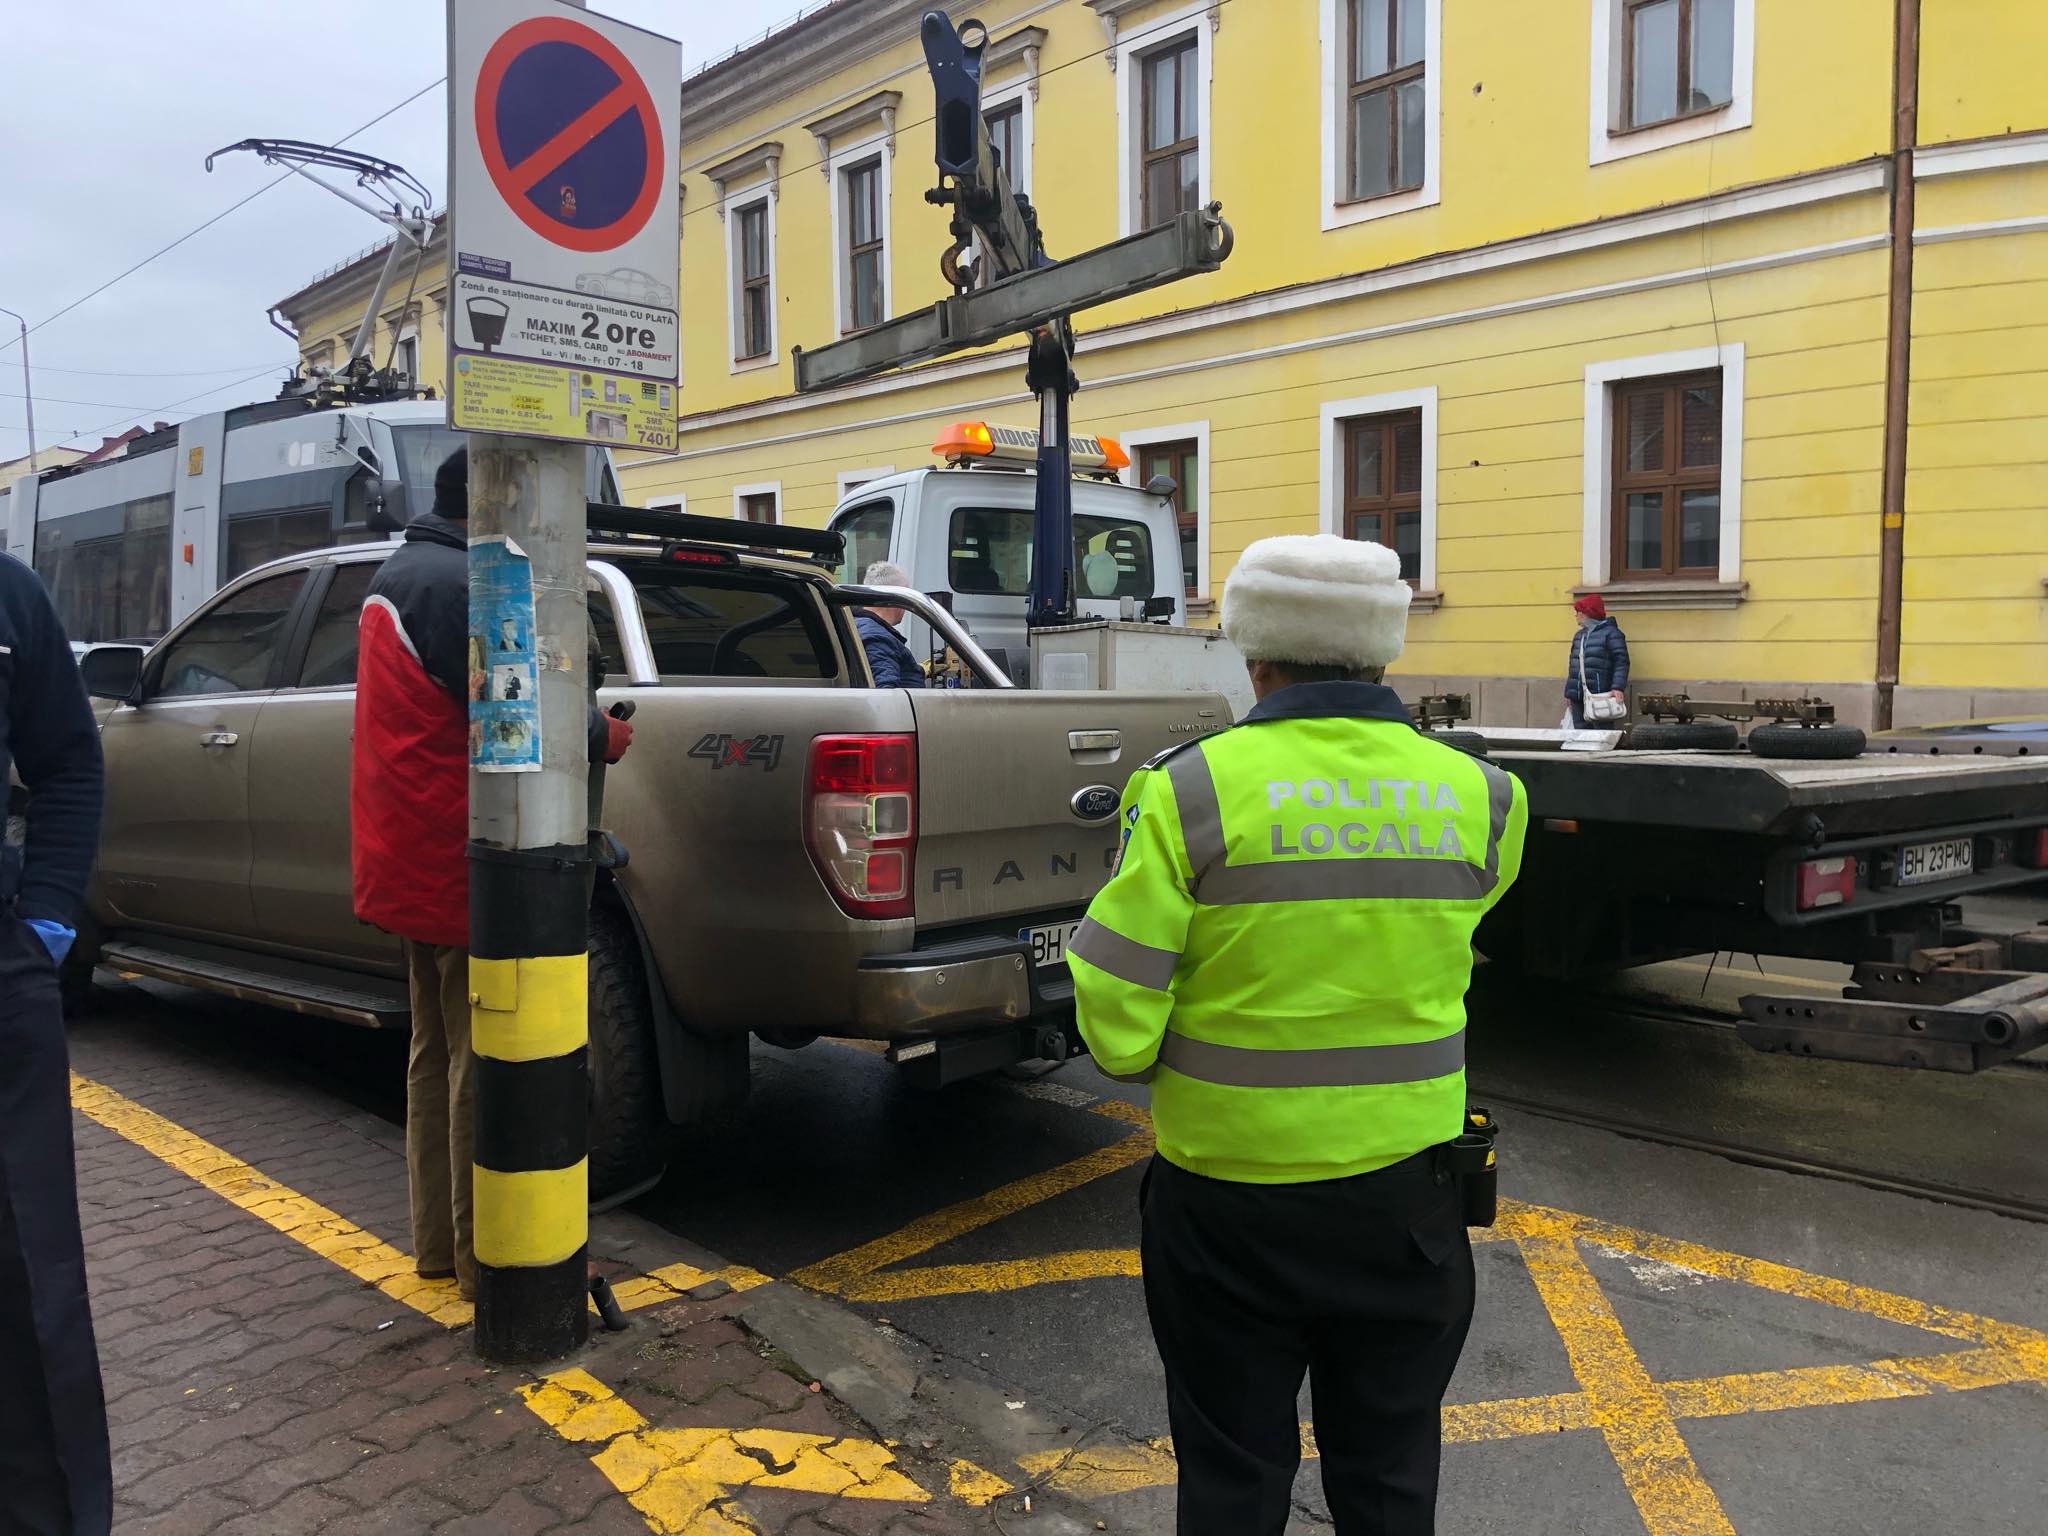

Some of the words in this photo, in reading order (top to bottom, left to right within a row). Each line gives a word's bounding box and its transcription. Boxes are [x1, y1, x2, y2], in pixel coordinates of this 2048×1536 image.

[460, 280, 485, 291] Zonă
[487, 285, 500, 295] de
[630, 310, 643, 320] CU
[520, 331, 556, 347] TICHET,
[559, 337, 581, 349] SMS,
[584, 341, 608, 352] CARD
[526, 317, 576, 336] MAXIM
[581, 311, 600, 340] 2
[606, 323, 656, 349] ore
[559, 350, 568, 359] Vi
[575, 353, 586, 362] Mo
[607, 356, 621, 367] 07
[630, 360, 643, 371] 18
[625, 349, 672, 362] ABONAMENT
[645, 416, 663, 426] SMS
[637, 430, 671, 447] 7401
[1085, 790, 1117, 814] Ford
[1266, 777, 1462, 820] POLIȚIA
[1270, 819, 1464, 857] LOCALĂ
[1904, 847, 1925, 876] BH
[1031, 930, 1062, 962] BH
